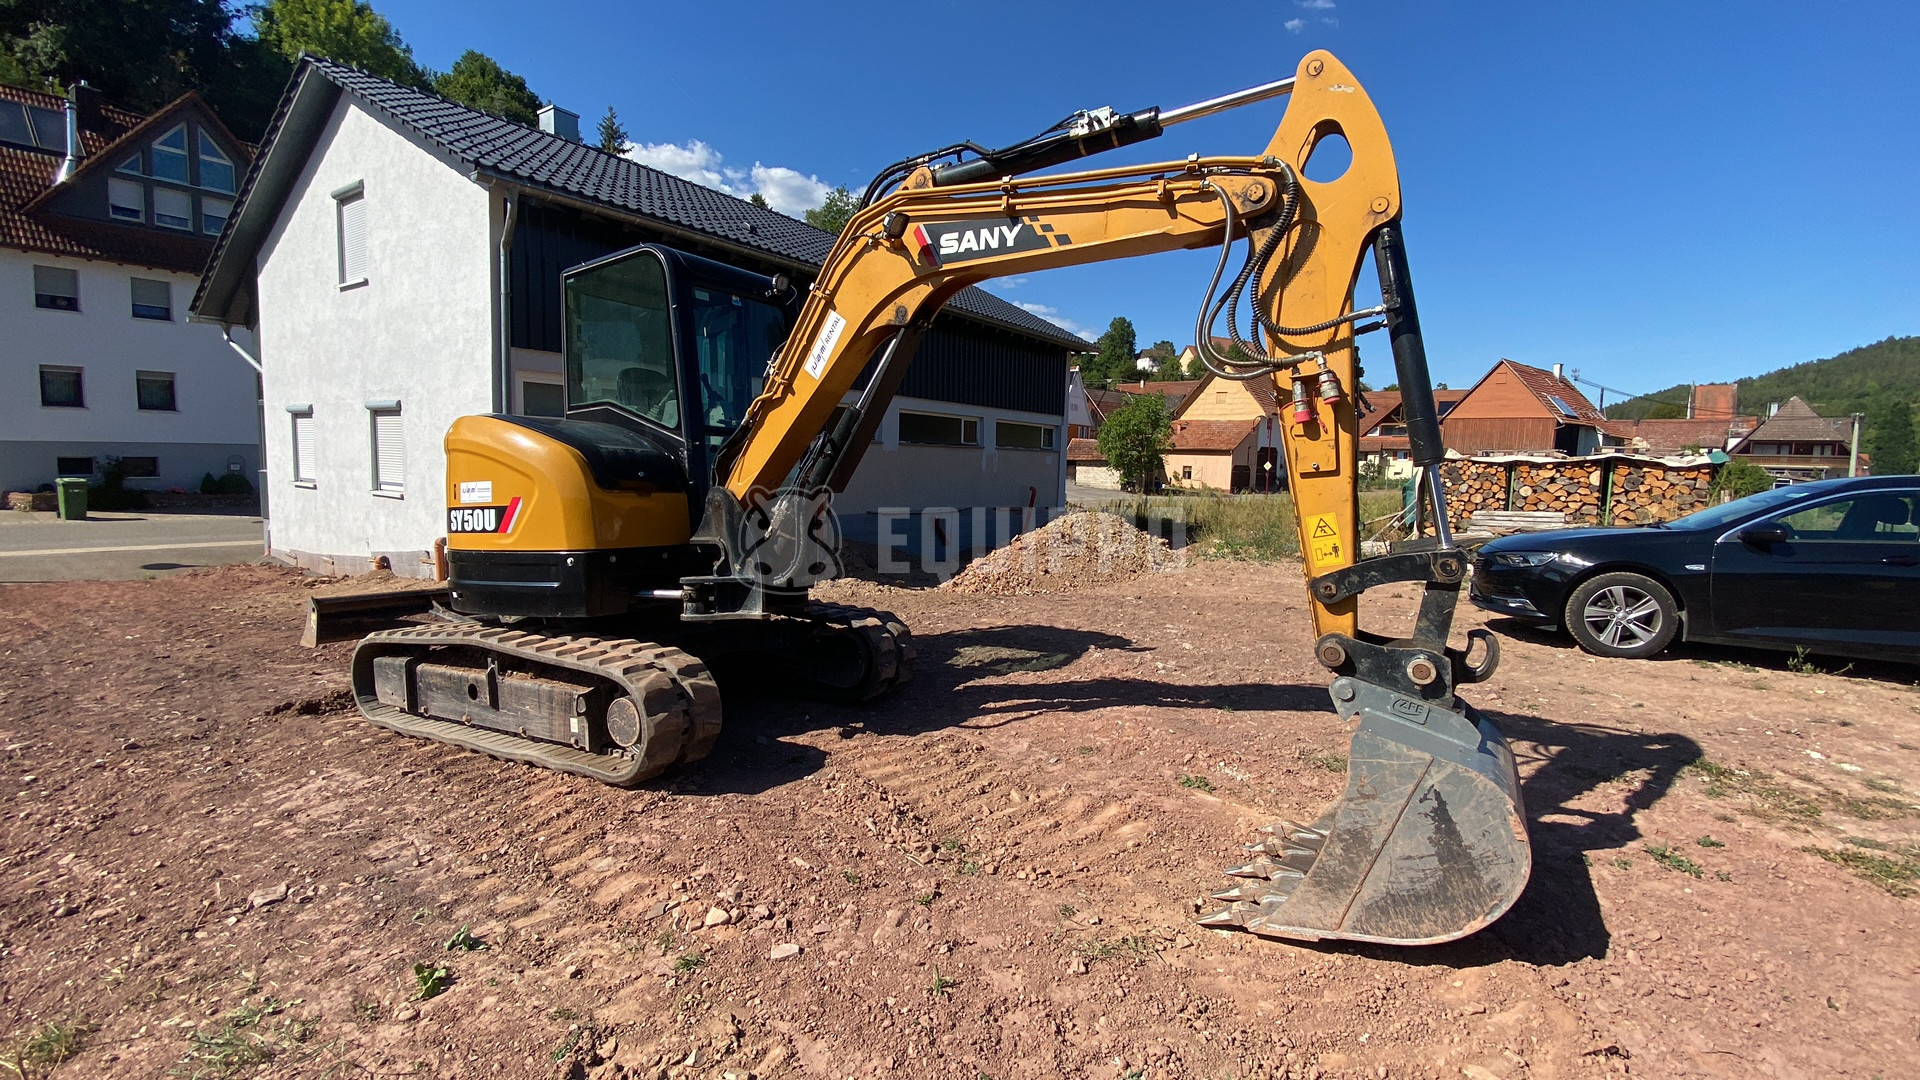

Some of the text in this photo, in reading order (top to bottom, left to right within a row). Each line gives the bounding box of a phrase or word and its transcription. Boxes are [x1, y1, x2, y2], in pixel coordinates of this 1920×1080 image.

[940, 223, 1024, 255] SANY
[825, 316, 841, 345] RENTAL
[450, 508, 496, 532] SY50U
